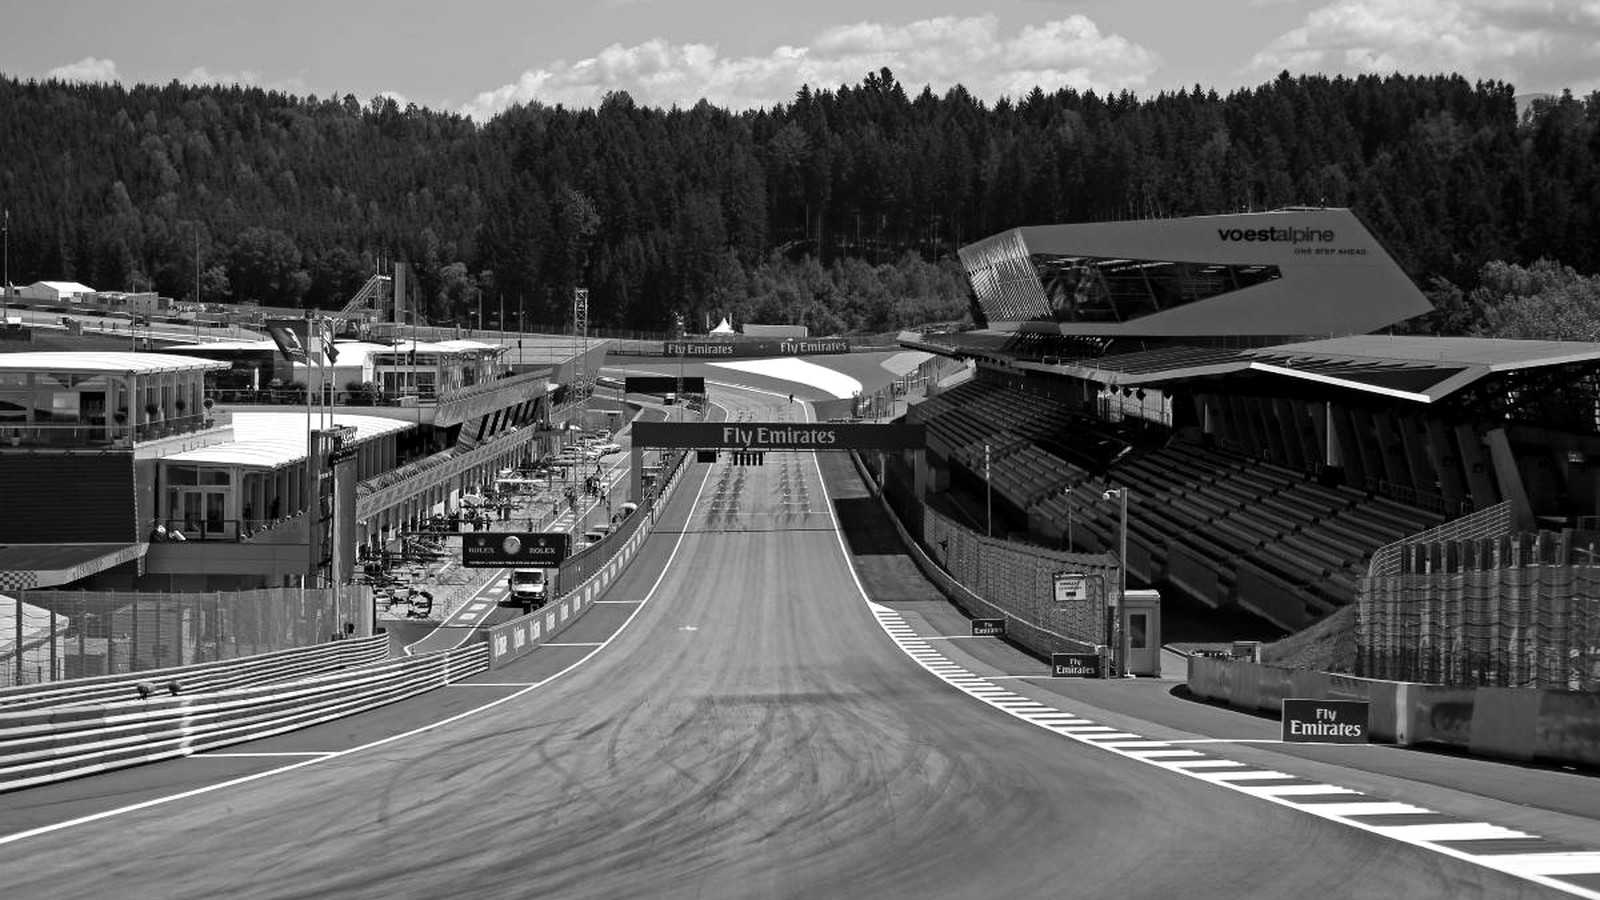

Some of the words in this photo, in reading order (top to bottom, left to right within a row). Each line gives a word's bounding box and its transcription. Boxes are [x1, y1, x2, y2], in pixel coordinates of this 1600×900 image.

[1218, 226, 1334, 244] voestalpine
[668, 344, 686, 355] Fly
[688, 344, 733, 355] Emirates
[780, 342, 798, 353] Fly
[800, 341, 848, 352] Emirates
[723, 427, 753, 447] Fly
[757, 427, 836, 444] Emirates
[1056, 665, 1095, 674] Emirates
[1316, 708, 1337, 721] Fly
[1290, 720, 1362, 737] Emirates
